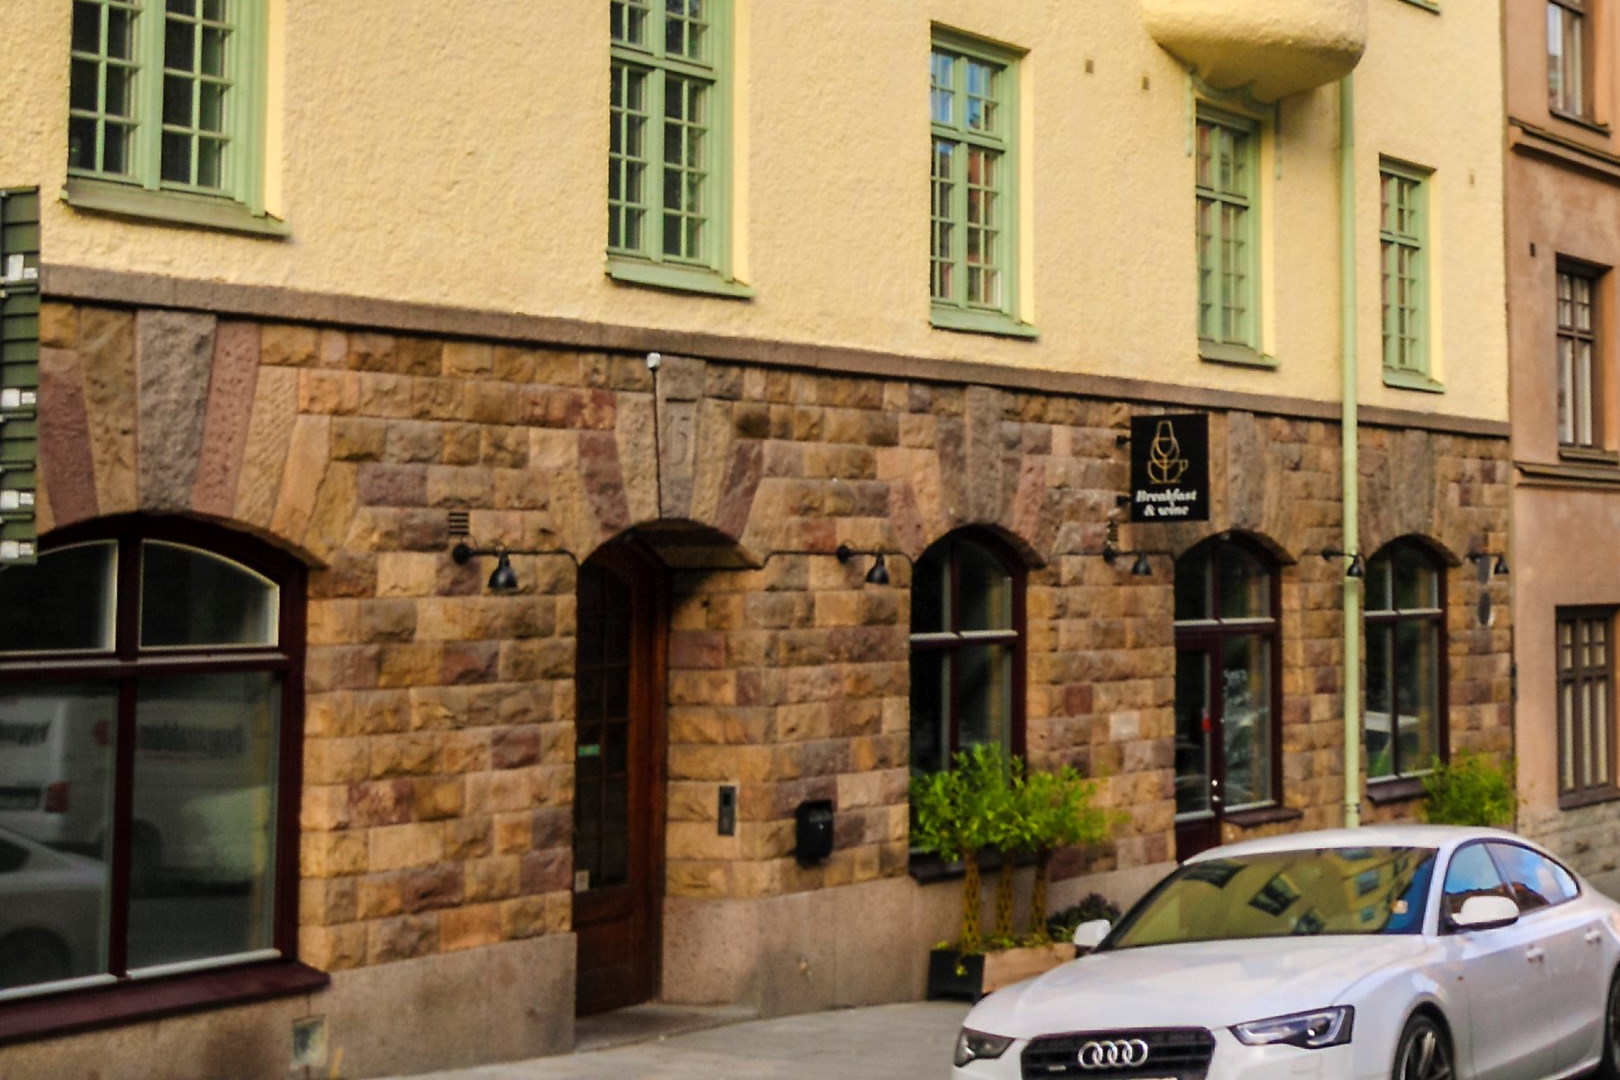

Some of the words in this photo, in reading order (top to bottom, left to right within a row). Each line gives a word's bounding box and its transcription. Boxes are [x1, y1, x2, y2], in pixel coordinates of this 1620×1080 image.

[1136, 488, 1197, 503] Breakfast
[1144, 504, 1155, 516] &
[1158, 503, 1189, 516] wine
